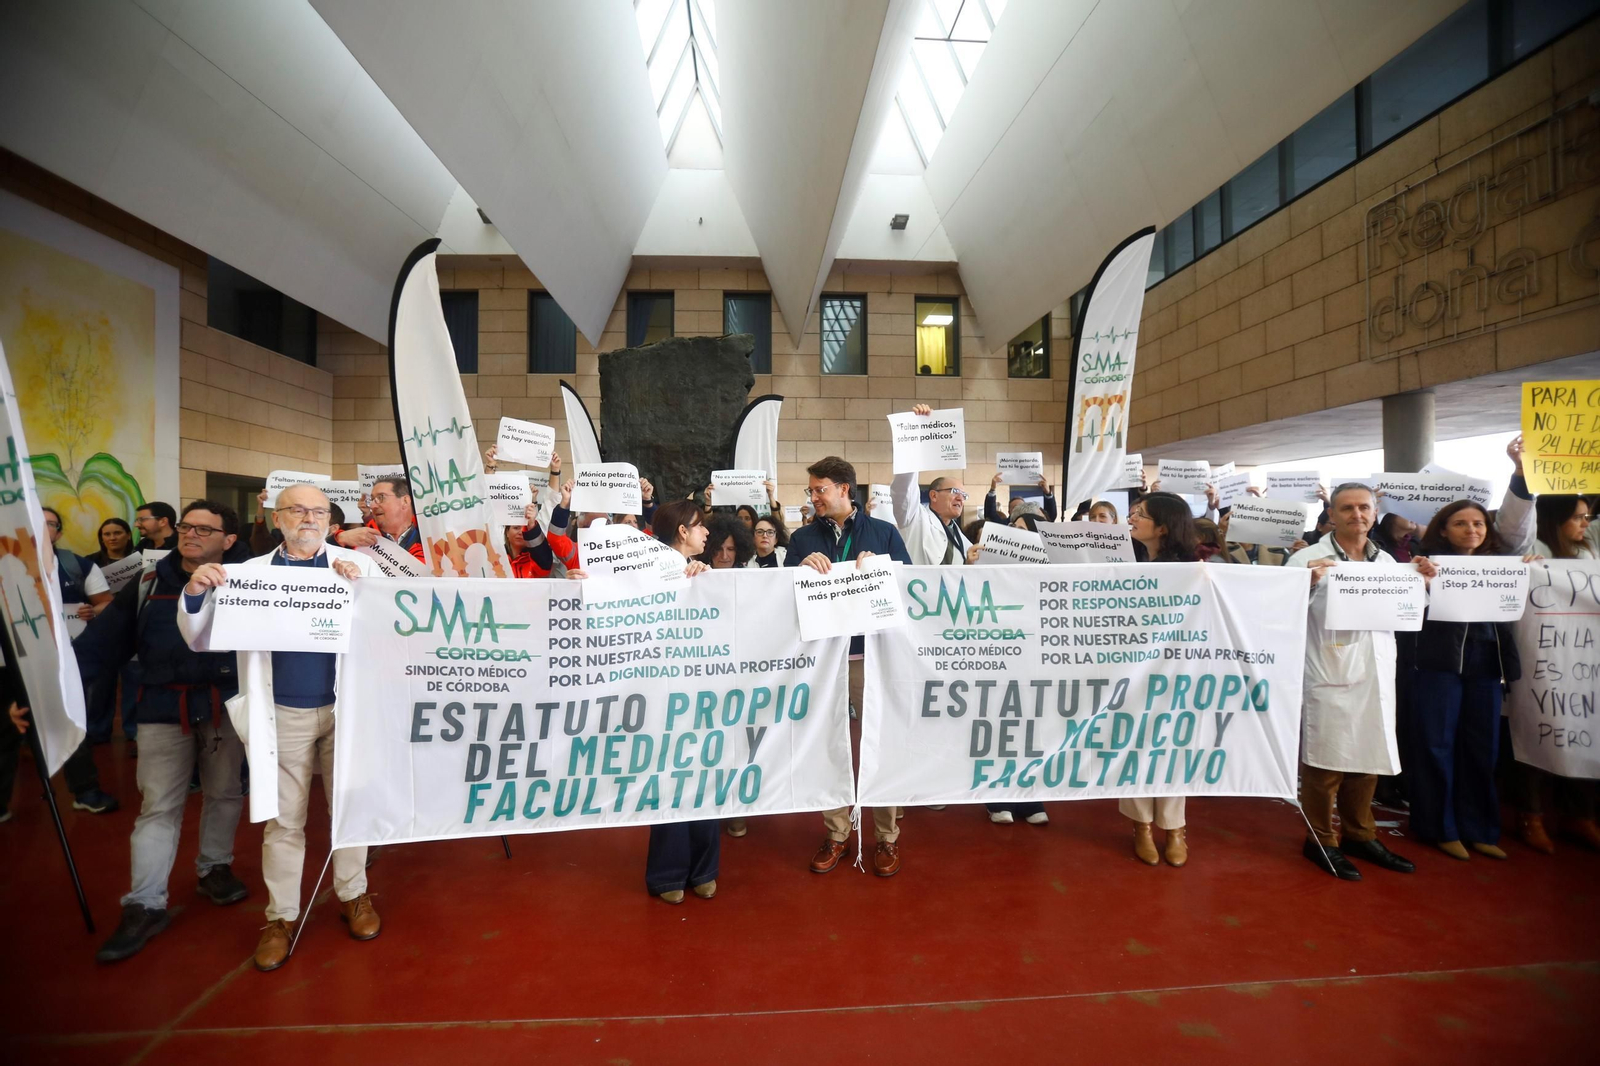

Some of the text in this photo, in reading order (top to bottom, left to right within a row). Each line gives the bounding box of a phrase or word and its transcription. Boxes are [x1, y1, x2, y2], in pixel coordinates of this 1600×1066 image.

[1369, 247, 1539, 342] dona
[1081, 351, 1128, 374] SMA
[1531, 386, 1577, 408] PARA
[920, 420, 956, 429] médicos,
[1533, 412, 1585, 432] NO TE
[510, 433, 523, 443] hay
[897, 431, 957, 445] sobran políticos”
[1538, 433, 1561, 454] 24
[578, 470, 606, 479] ¡Mónica
[1533, 459, 1573, 475] PERO
[489, 482, 523, 492] médicos,
[608, 481, 639, 490] guardia!
[1420, 482, 1465, 492] traidora!
[1406, 493, 1420, 501] 24
[1422, 494, 1454, 503] horas!
[1233, 503, 1304, 518] “Médico quemado,
[1230, 512, 1305, 527] sistema colapsado”
[583, 542, 602, 551] “De
[605, 536, 639, 550] España
[986, 533, 1020, 548] ¡Mónica
[1085, 531, 1129, 542] dignidad,
[587, 552, 624, 566] porque
[626, 548, 647, 561] aquí
[1000, 548, 1018, 559] tú la
[613, 557, 659, 574] porvenir”
[1437, 567, 1528, 578] ¡Mónica, traidora!
[795, 568, 892, 590] “Menos explotación,
[1039, 575, 1158, 593] POR FORMACIÓN
[1330, 573, 1422, 584] “Menos explotación,
[1441, 580, 1518, 590] ¡Stop 24 horas!
[280, 582, 349, 597] quemado,
[807, 581, 884, 601] más protección”
[1339, 586, 1413, 597] más protección”
[217, 594, 350, 612] sistema colapsado”
[548, 598, 582, 612] POR
[907, 574, 1024, 626] SMA
[1039, 594, 1201, 611] POR RESPONSABILIDAD
[393, 587, 531, 646] SMA
[548, 607, 720, 631] POR RESPONSABILIDAD
[1040, 613, 1184, 629] POR NUESTRA SALUD
[548, 627, 704, 650] POR NUESTRA SALUD
[1040, 630, 1208, 647] POR NUESTRAS FAMILIAS
[1537, 623, 1594, 649] EN LA
[548, 644, 730, 669] POR NUESTRAS FAMILIAS
[917, 644, 1022, 657] SINDICATO MÉDICO
[1041, 648, 1275, 665] POR LA DIGNIDAD DE UNA PROFESIÓN
[404, 664, 528, 678] SINDICATO MÉDICO
[549, 653, 816, 688] POR LA DIGNIDAD DE UNA PROFESIÓN
[935, 658, 1007, 671] DE CÓRDOBA
[1533, 660, 1563, 681] ES
[427, 679, 510, 693] DE CÓRDOBA
[921, 673, 1271, 718] ESTATUTO PROPIO
[410, 682, 810, 743] ESTATUTO PROPIO
[969, 704, 1235, 758] DEL MÉDICO Y
[1538, 721, 1592, 748] PERO
[464, 725, 769, 783] DEL MÉDICO Y
[969, 748, 1227, 791] FACULTATIVO
[462, 764, 763, 824] FACULTATIVO
